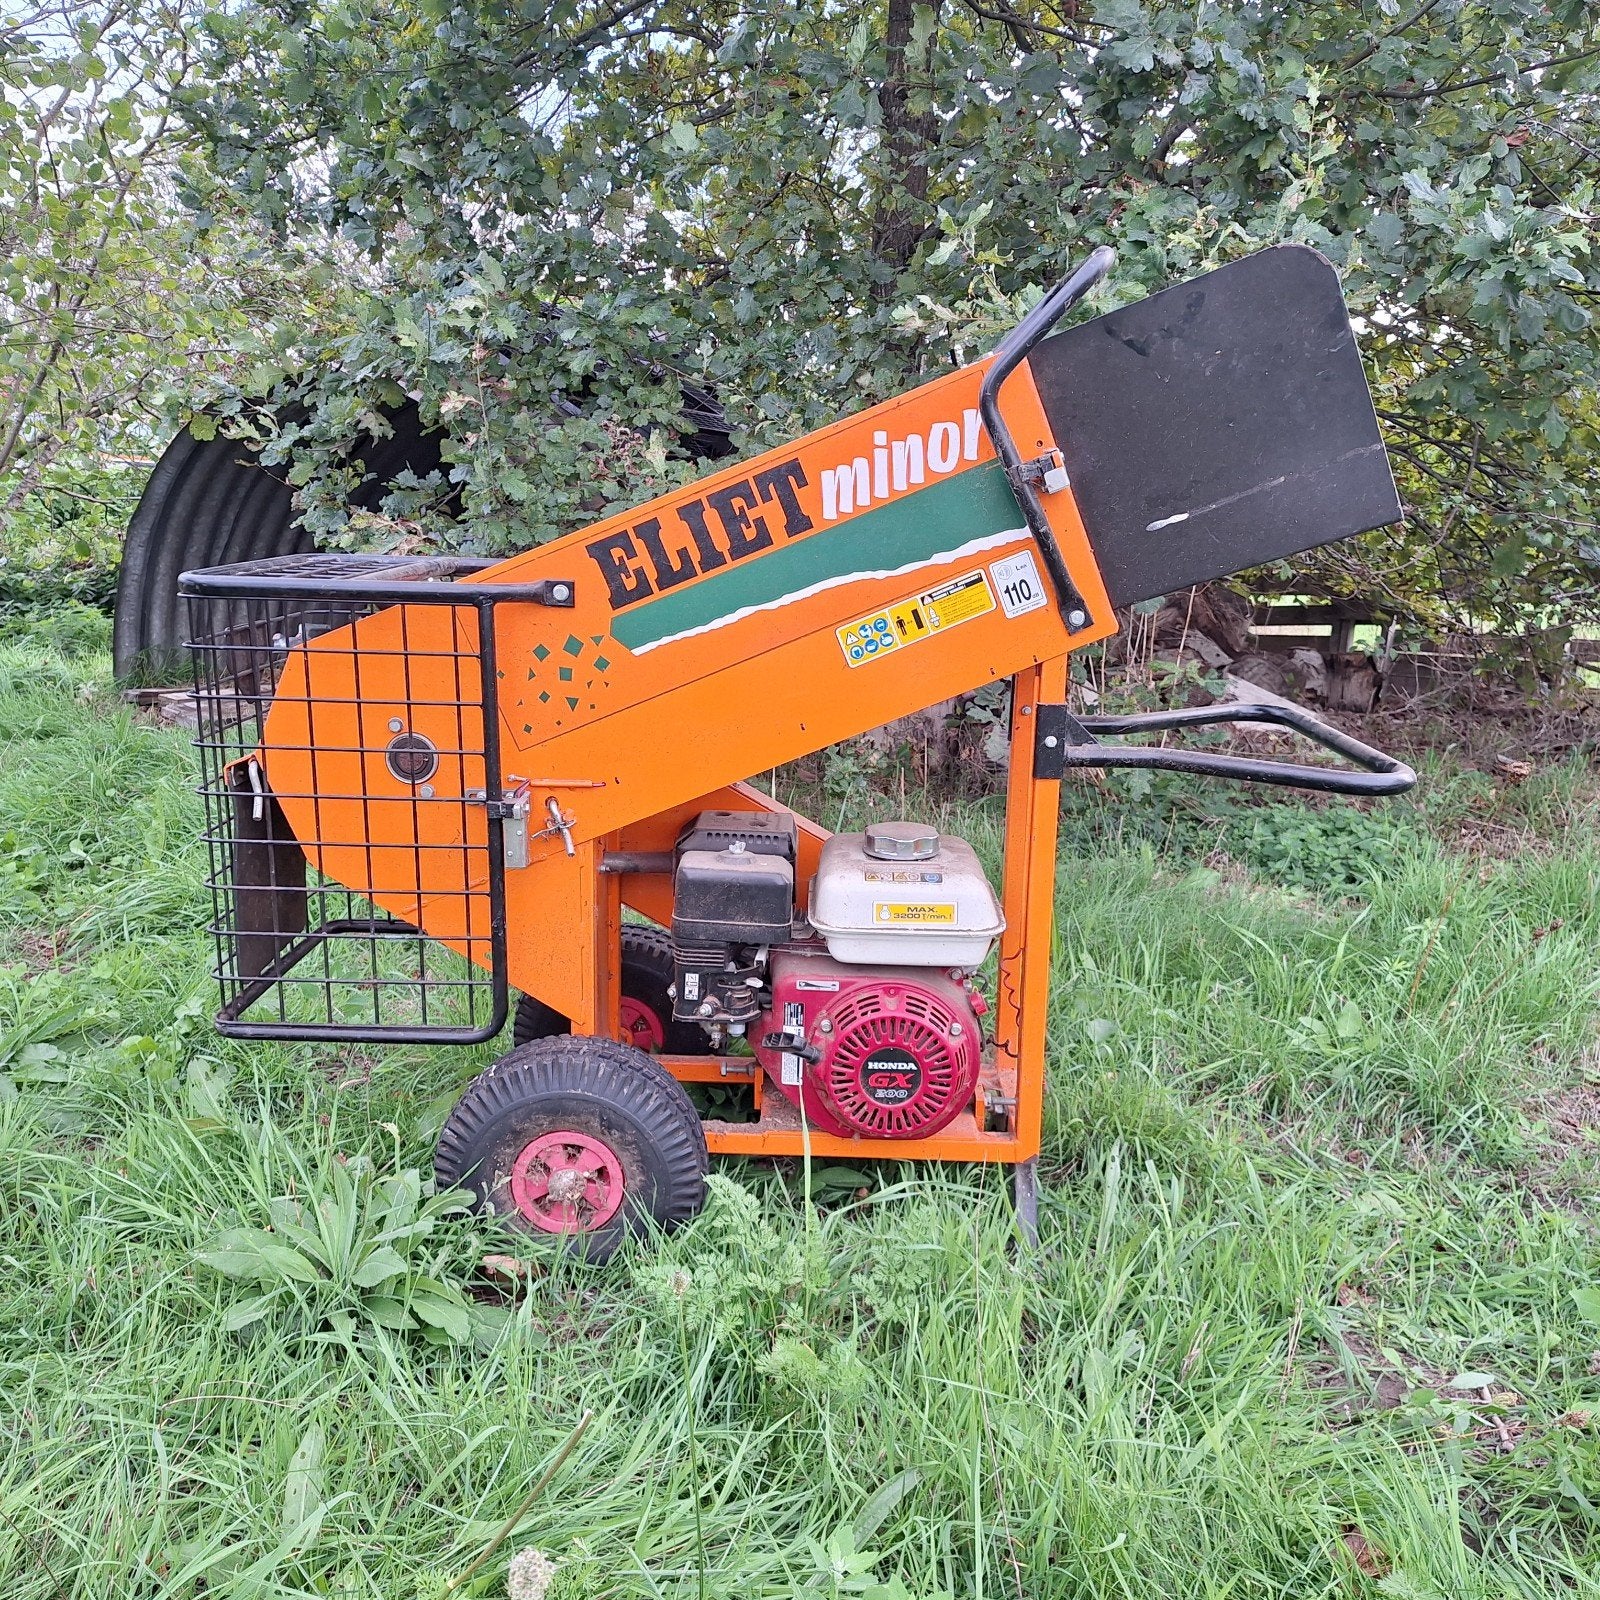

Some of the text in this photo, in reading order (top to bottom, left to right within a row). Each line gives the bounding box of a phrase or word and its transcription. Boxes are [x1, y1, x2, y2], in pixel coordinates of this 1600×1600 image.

[585, 458, 814, 611] ELIET
[1004, 579, 1032, 607] 110
[867, 1061, 918, 1070] HONDA
[868, 1072, 915, 1088] GX
[875, 1088, 908, 1098] 200
